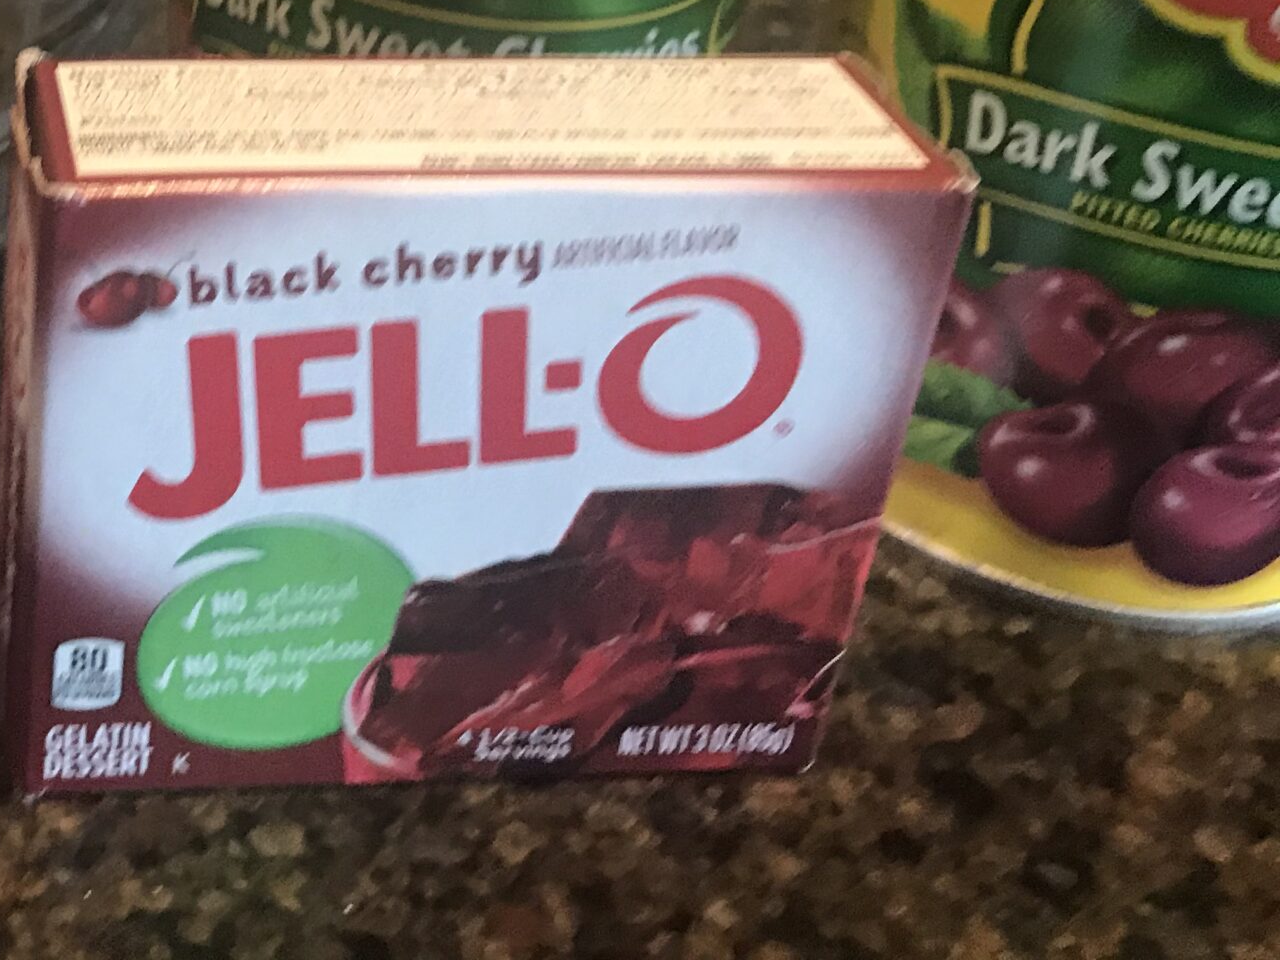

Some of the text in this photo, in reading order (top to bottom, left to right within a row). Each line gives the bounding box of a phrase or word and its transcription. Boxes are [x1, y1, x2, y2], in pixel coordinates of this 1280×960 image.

[965, 89, 1116, 189] Dark
[188, 249, 341, 308] black
[361, 240, 543, 288] cherry
[126, 272, 804, 521] JELL-O
[71, 646, 109, 671] 80
[44, 721, 151, 754] GELATIN
[617, 724, 657, 756] NET
[43, 746, 154, 780] DESSERT
